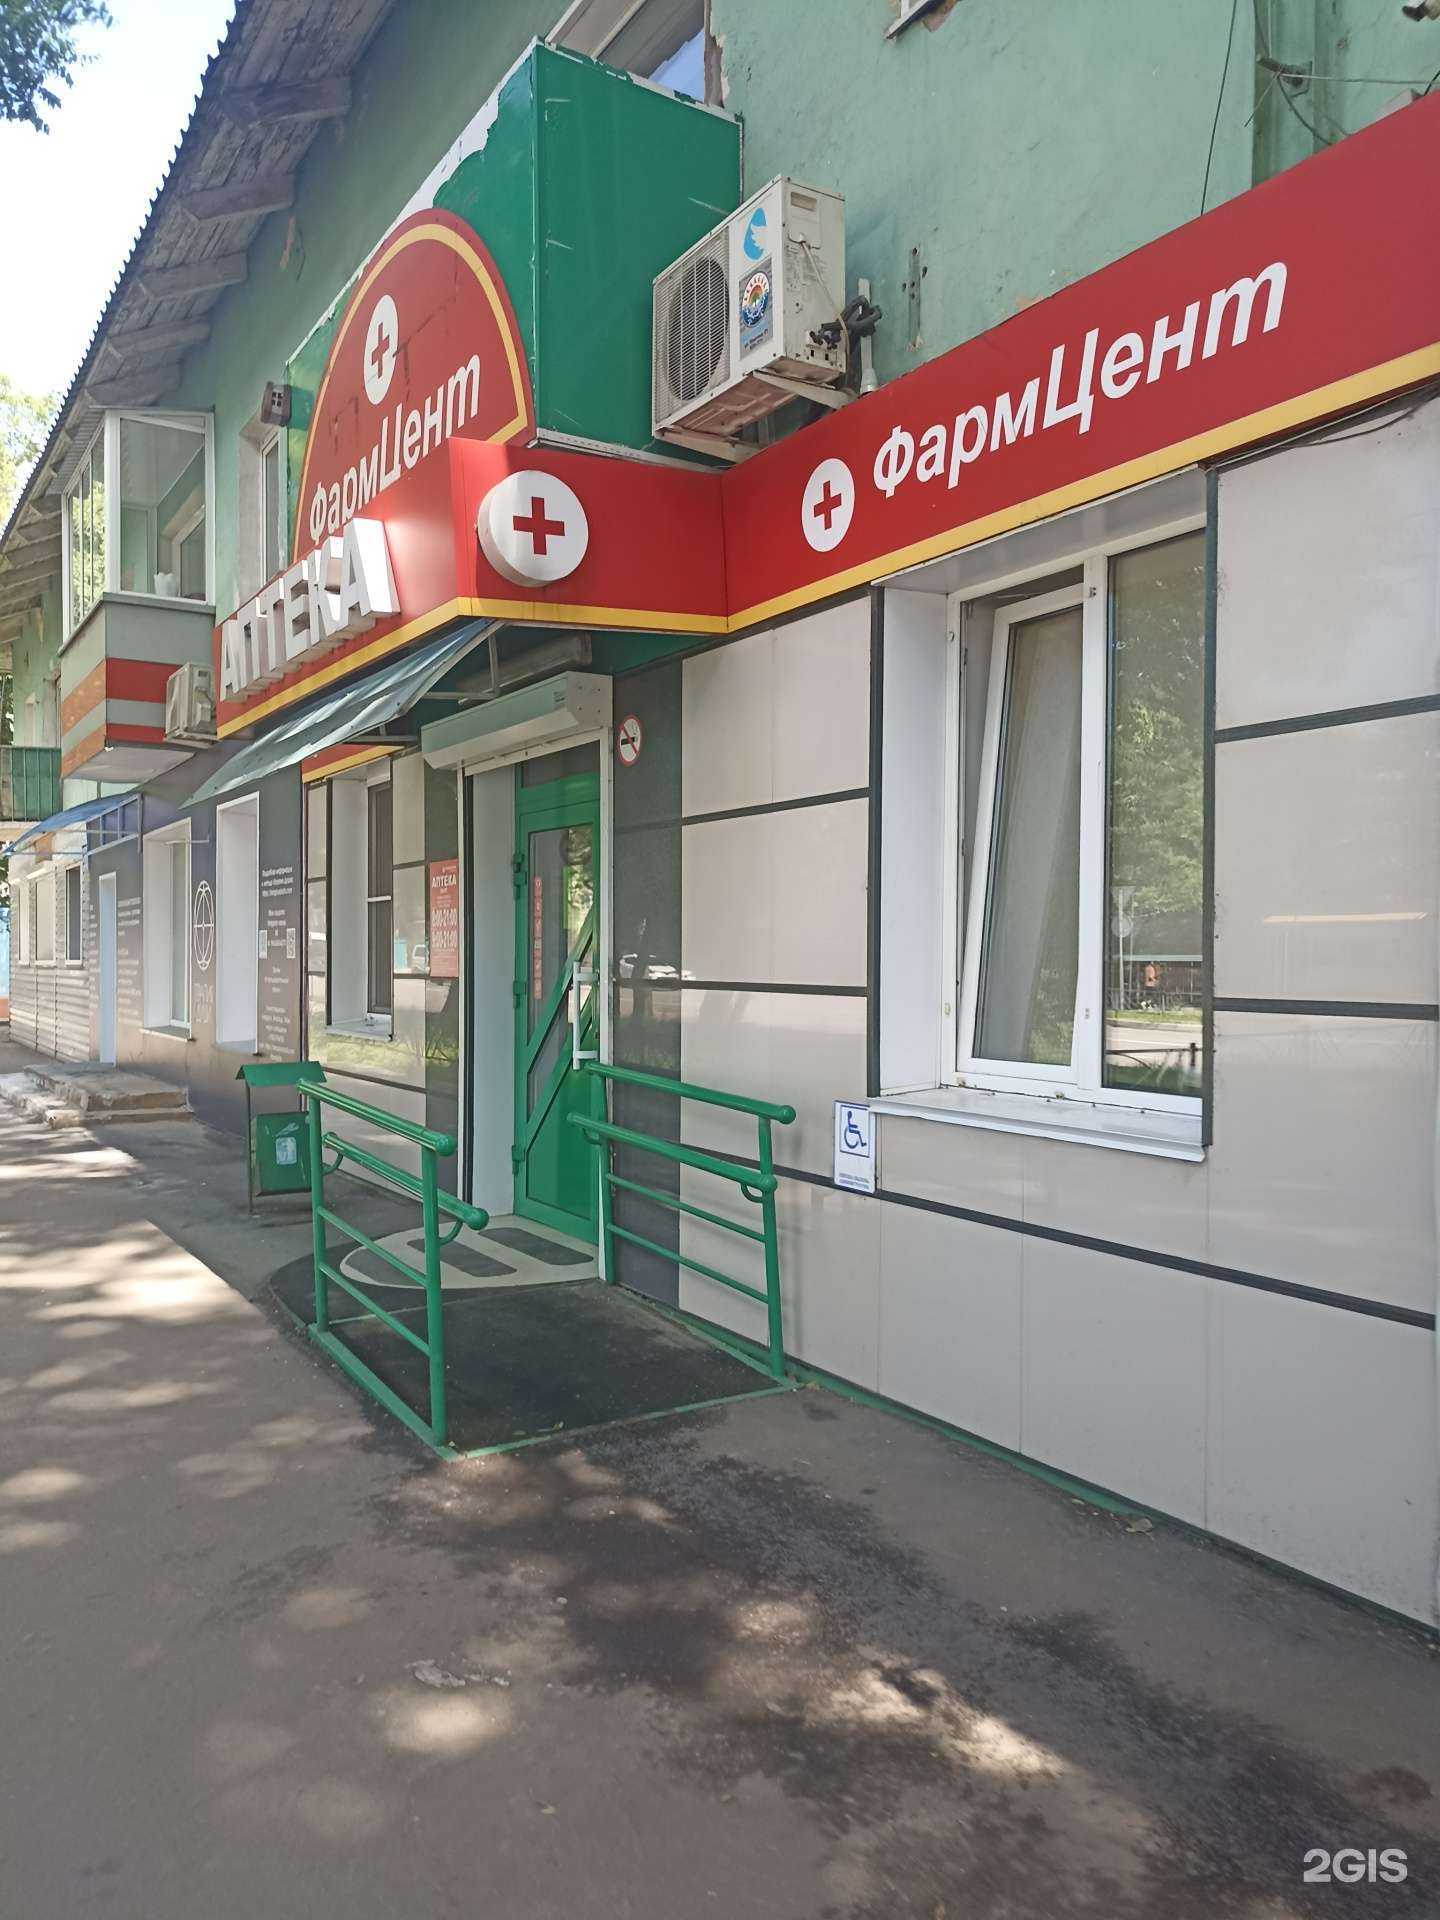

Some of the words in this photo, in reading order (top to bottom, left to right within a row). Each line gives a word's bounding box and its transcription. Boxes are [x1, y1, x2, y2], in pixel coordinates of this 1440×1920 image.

[309, 354, 481, 544] ФармЦент
[873, 261, 1288, 499] ФармЦент
[219, 517, 400, 703] АПТЕКА
[431, 873, 457, 888] АПТЕКА
